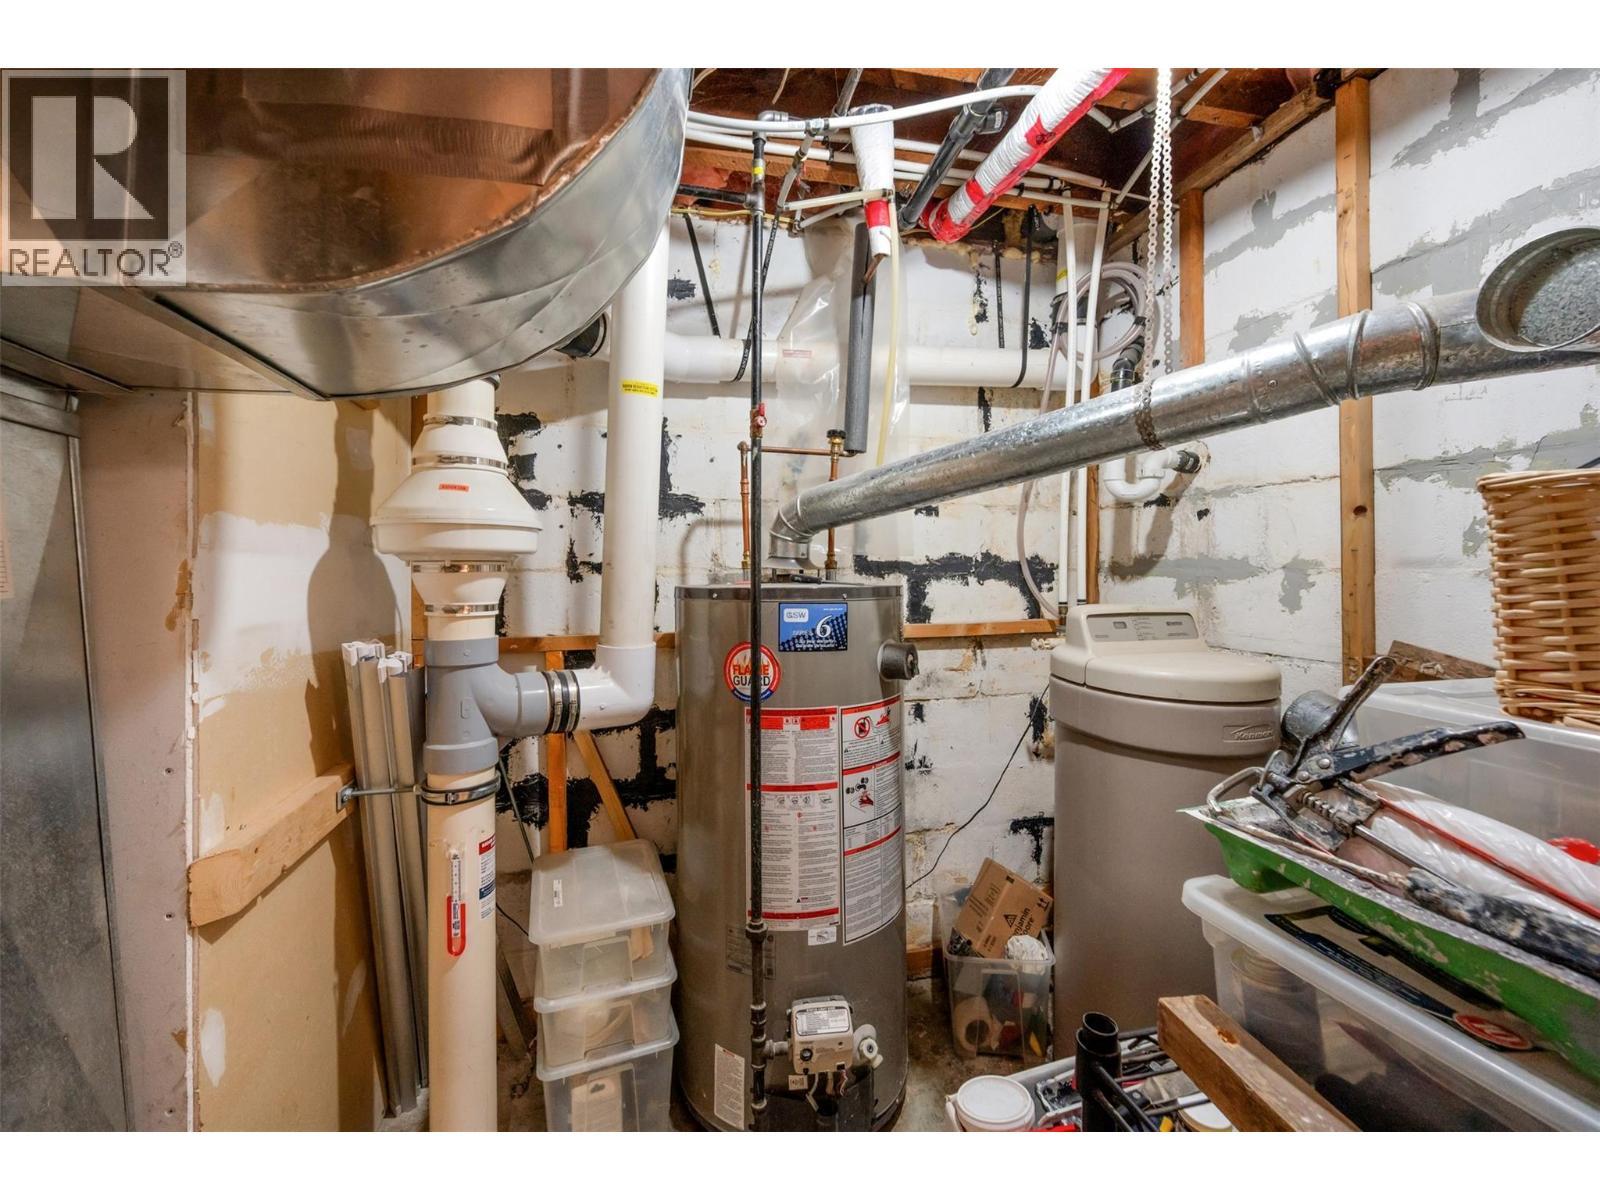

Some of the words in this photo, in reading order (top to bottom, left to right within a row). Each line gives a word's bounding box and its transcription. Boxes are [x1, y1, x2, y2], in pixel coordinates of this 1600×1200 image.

[785, 611, 807, 619] GSW
[816, 614, 833, 638] 6
[732, 664, 769, 676] FLAE
